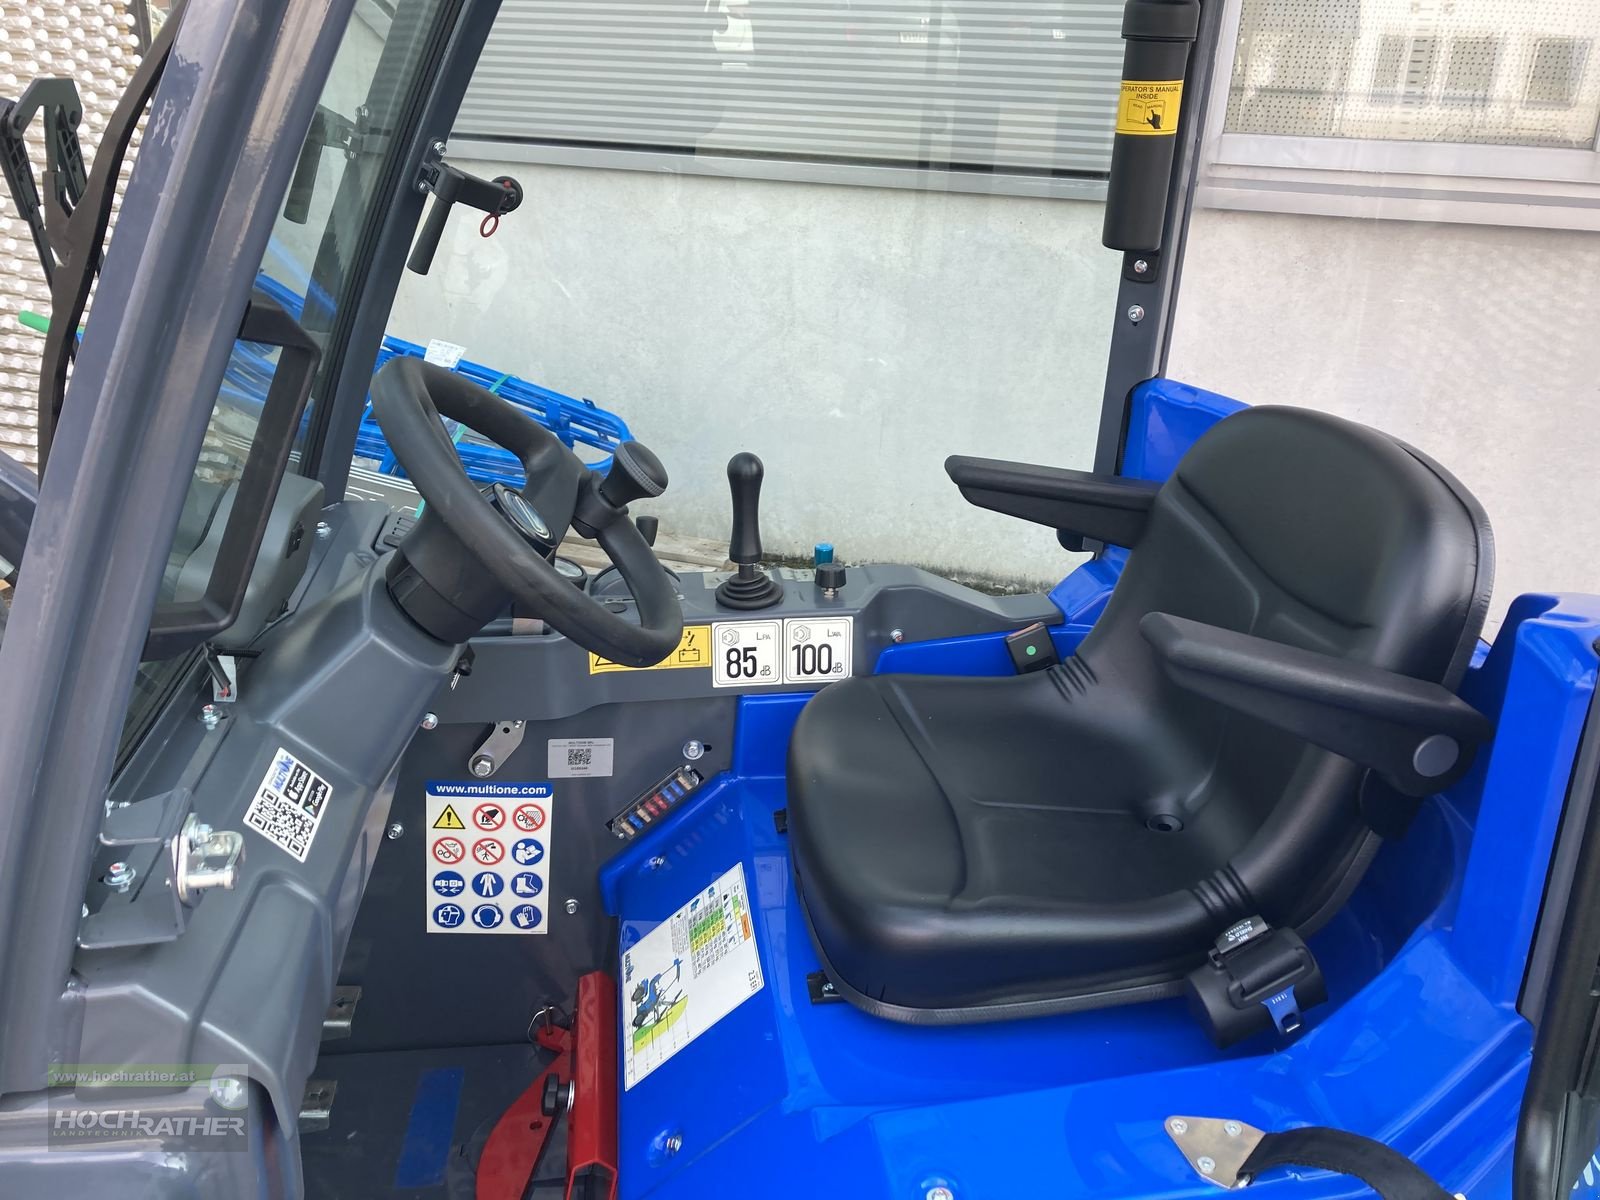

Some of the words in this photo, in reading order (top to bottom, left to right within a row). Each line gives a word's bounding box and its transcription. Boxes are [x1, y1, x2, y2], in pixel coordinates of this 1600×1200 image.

[726, 646, 757, 678] 85
[791, 643, 832, 676] 100
[760, 664, 771, 677] dB
[832, 661, 843, 674] dB
[436, 784, 547, 795] www.multione.com
